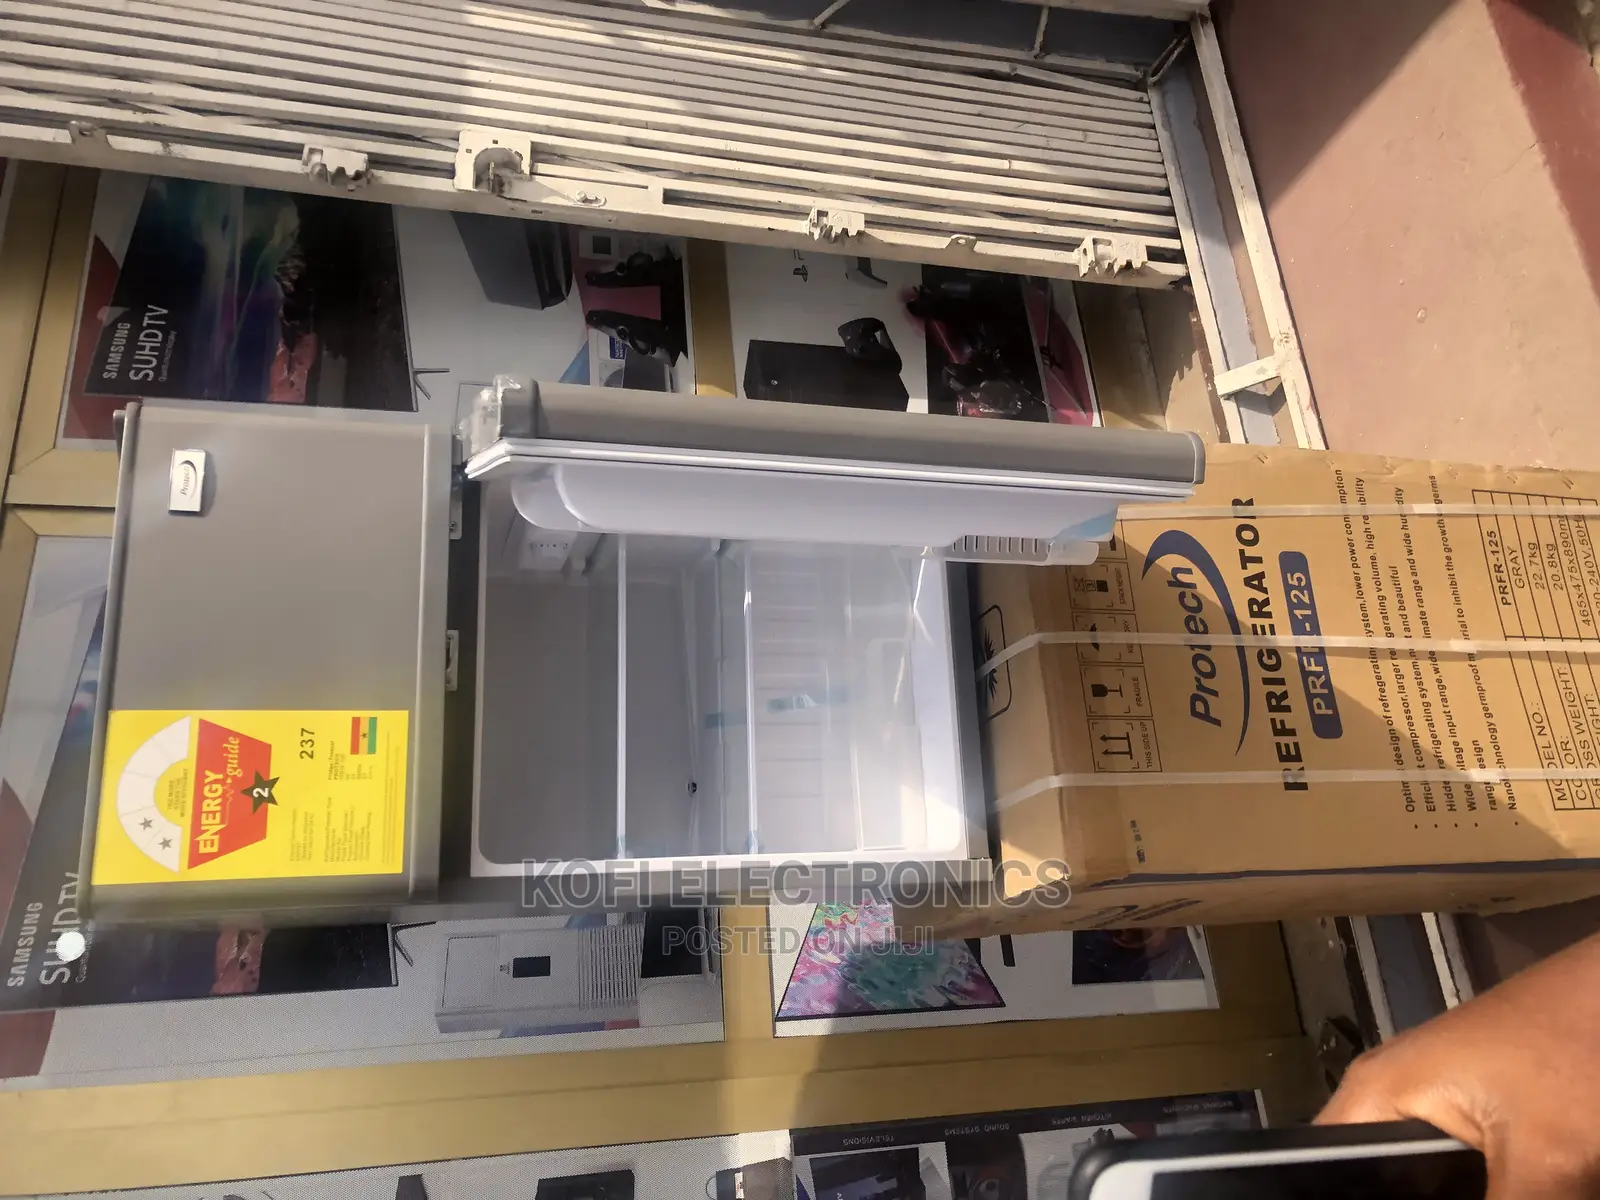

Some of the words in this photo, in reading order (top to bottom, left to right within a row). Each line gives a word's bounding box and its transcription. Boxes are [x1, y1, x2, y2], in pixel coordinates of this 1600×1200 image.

[102, 322, 131, 379] SAMSUNG
[1334, 469, 1352, 535] conmption
[1428, 475, 1443, 504] germs
[1361, 527, 1375, 550] high
[1402, 533, 1414, 556] wide
[1435, 518, 1451, 553] growth
[1346, 537, 1361, 569] power
[1406, 558, 1418, 577] and
[1441, 555, 1453, 571] the
[1486, 529, 1511, 606] PRFR-125
[1506, 545, 1525, 589] GRAY
[1527, 542, 1546, 590] 22.7kg
[1545, 543, 1564, 591] 20.8kg
[1370, 552, 1383, 593] volume,
[1388, 565, 1405, 612] beautiful
[1445, 573, 1462, 606] inhibit
[1413, 579, 1426, 608] range
[1398, 613, 1410, 633] and
[1456, 607, 1466, 618] to
[1166, 566, 1222, 728] Protech
[1231, 497, 1309, 792] REFRIGERATOR
[1459, 620, 1477, 662] mrial
[1131, 676, 1143, 707] FRAGILE
[1467, 664, 1493, 719] germproof
[1557, 666, 1585, 735] WEIGHT:
[1139, 721, 1147, 731] UP
[1383, 714, 1394, 726] of
[1421, 701, 1446, 769] refrigerating
[1444, 710, 1459, 738] input
[222, 736, 243, 777] guide
[299, 727, 316, 760] 237
[1141, 733, 1151, 750] SIDE
[1387, 728, 1404, 766] design
[1470, 739, 1487, 770] esign
[1144, 751, 1153, 768] THIS
[1560, 735, 1587, 800] COOR:
[252, 787, 269, 798] 2
[1416, 764, 1436, 812] Efficit
[1441, 779, 1457, 812] Hidde
[1462, 783, 1477, 811] Wide
[194, 770, 226, 854] ENERGY
[6, 902, 43, 987] SAMSUNG
